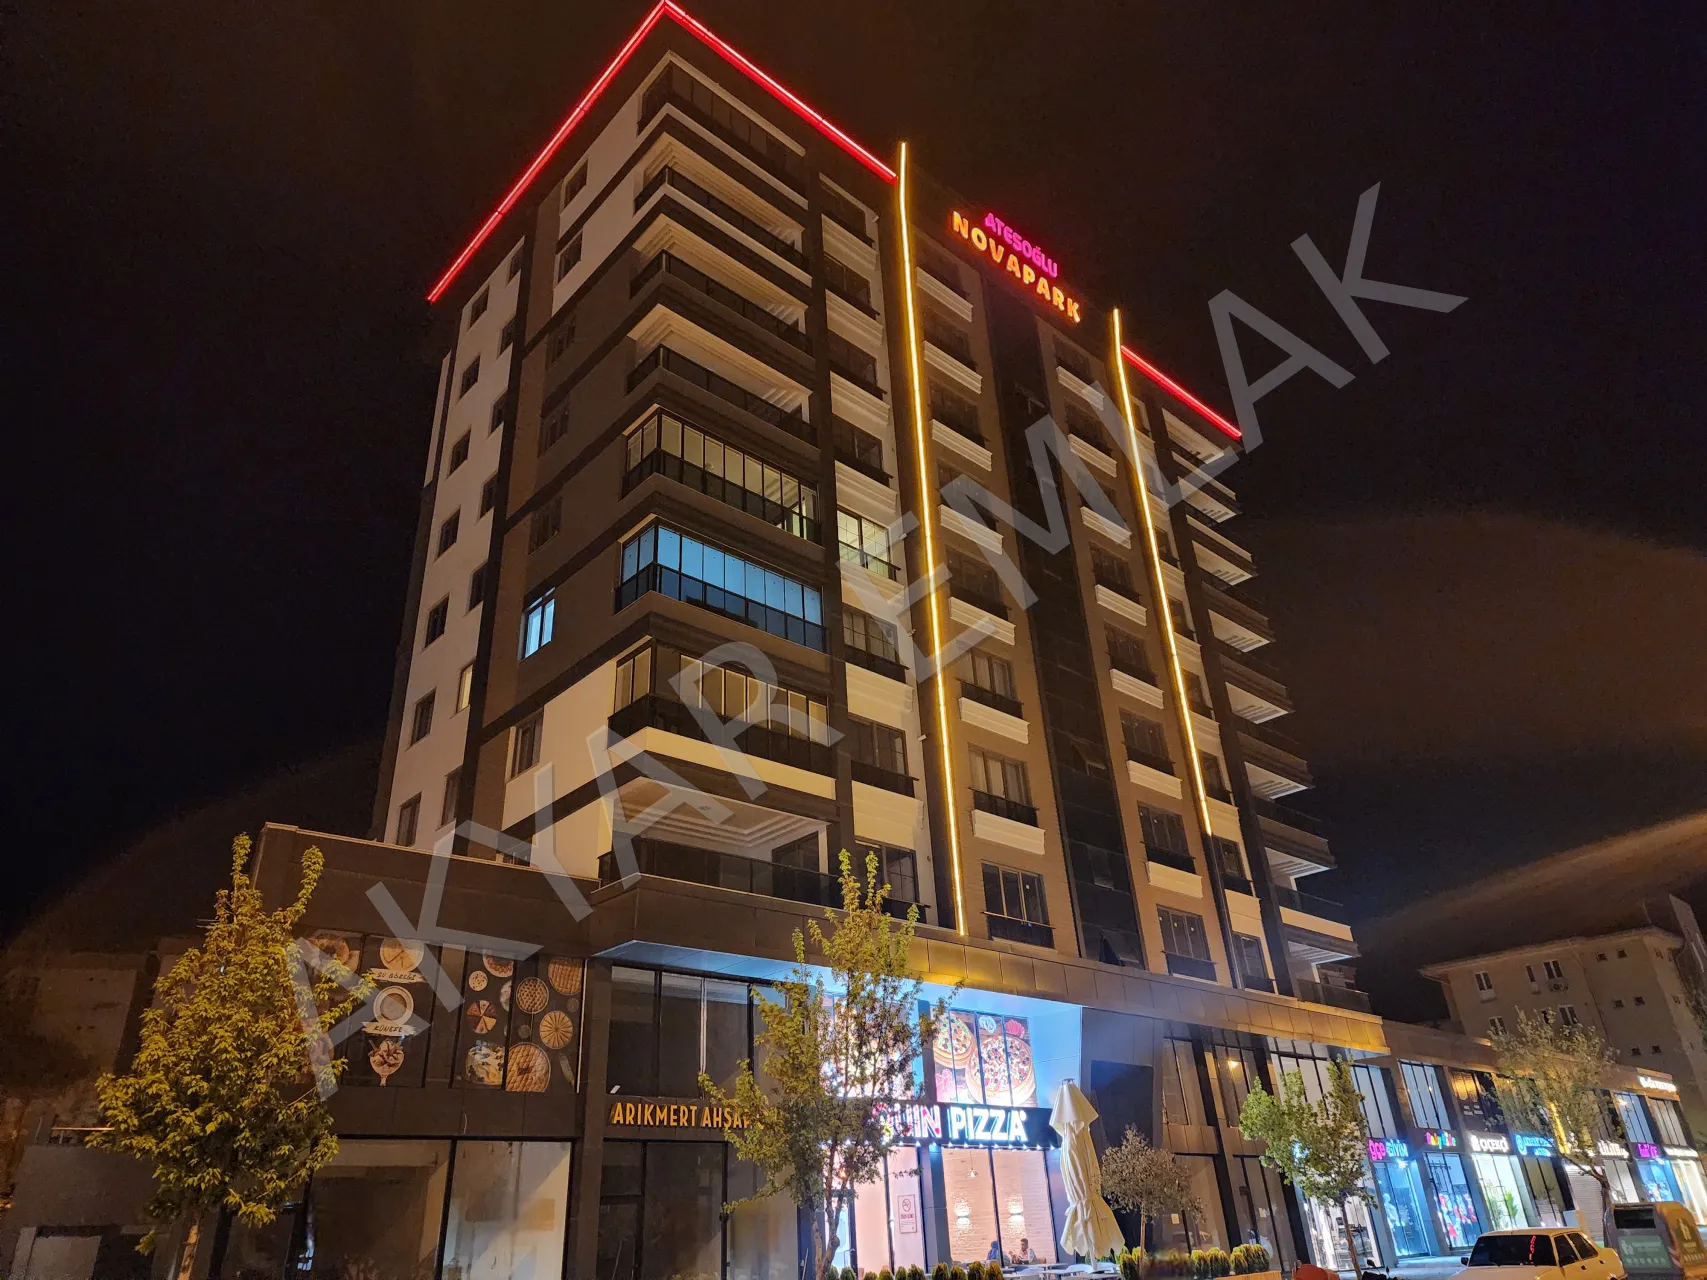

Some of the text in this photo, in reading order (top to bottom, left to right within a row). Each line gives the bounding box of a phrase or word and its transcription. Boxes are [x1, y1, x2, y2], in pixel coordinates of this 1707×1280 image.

[952, 211, 1081, 324] NOVAPARK
[612, 1102, 700, 1128] ARIKMERT
[947, 1106, 1029, 1142] PIZZA
